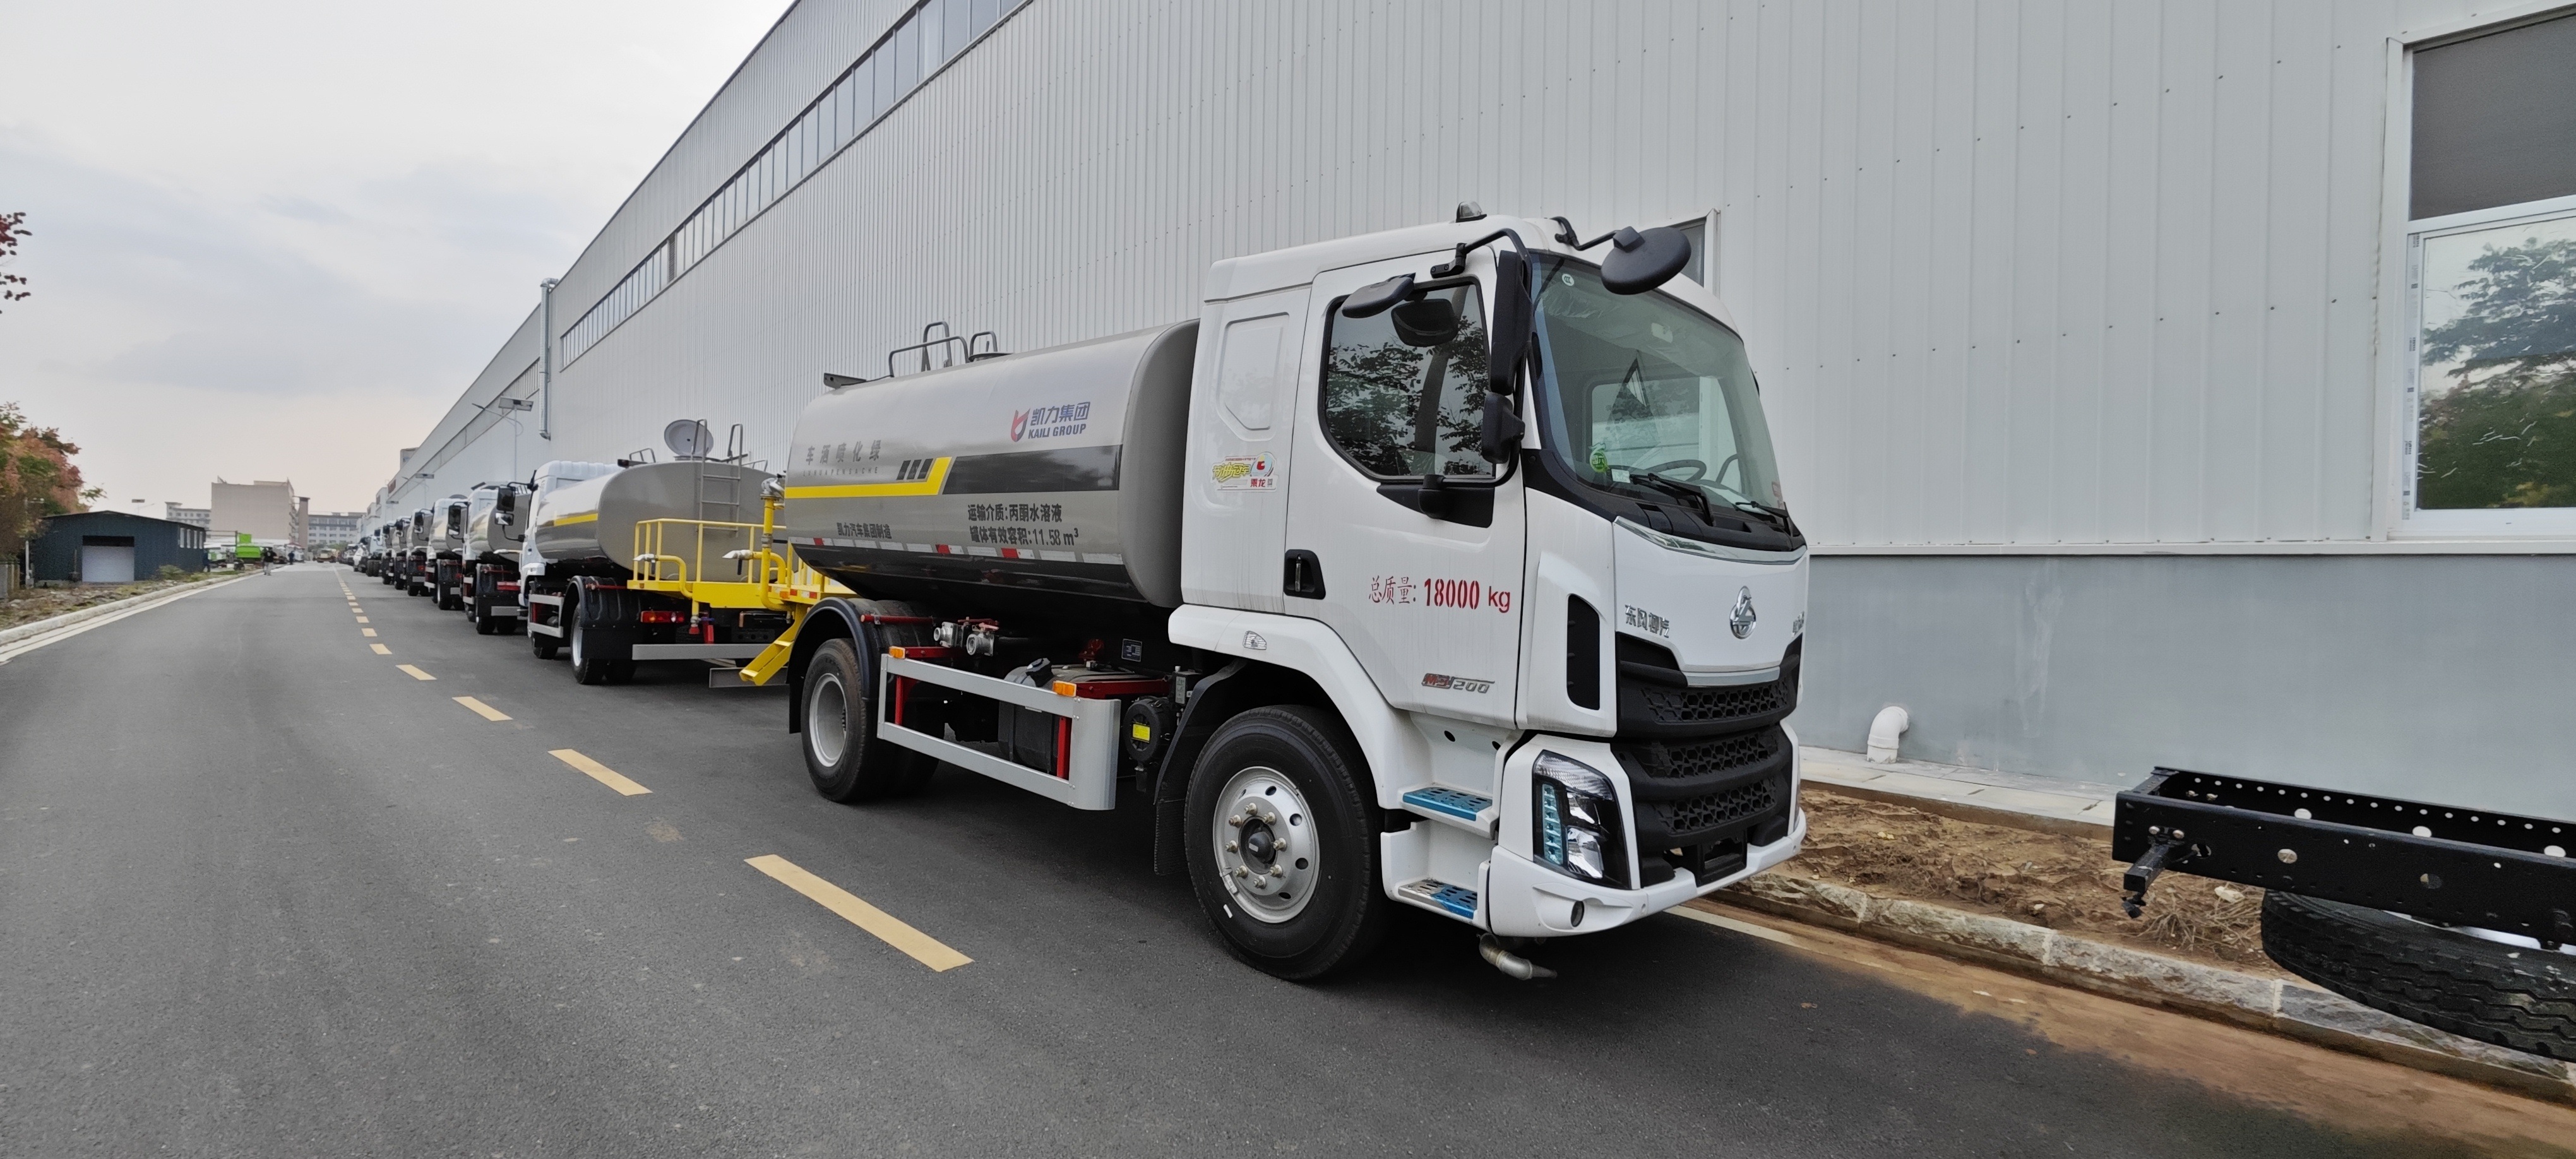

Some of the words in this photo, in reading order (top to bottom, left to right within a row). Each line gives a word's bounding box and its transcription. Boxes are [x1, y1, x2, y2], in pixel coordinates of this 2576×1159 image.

[1030, 401, 1090, 426] 凯力集团
[1028, 427, 1051, 439] KAILI
[1052, 424, 1087, 436] GROUP
[1424, 578, 1480, 610] 18000
[1488, 586, 1511, 614] kg
